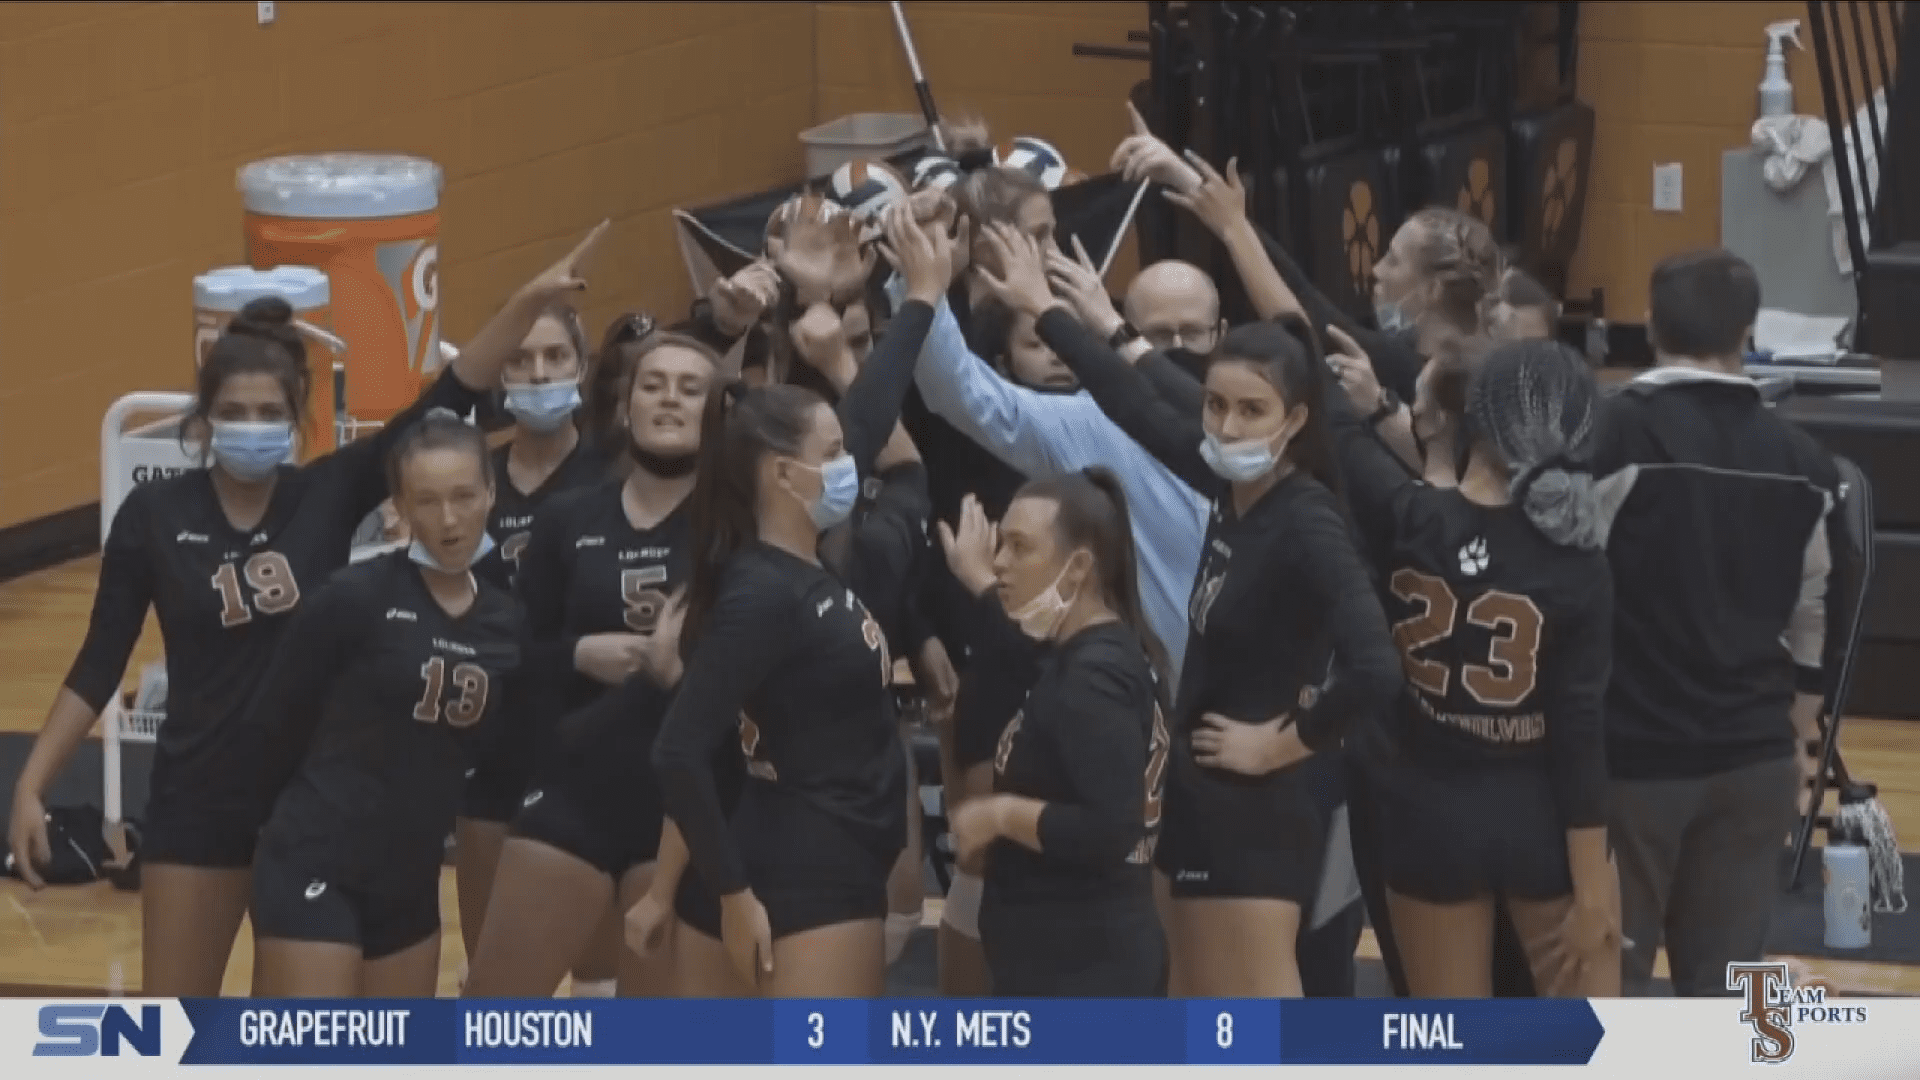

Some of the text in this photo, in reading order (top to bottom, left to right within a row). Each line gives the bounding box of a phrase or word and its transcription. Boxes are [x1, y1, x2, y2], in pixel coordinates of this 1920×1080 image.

[211, 550, 300, 628] 19
[621, 564, 667, 632] 5
[1390, 567, 1544, 706] 23
[413, 655, 489, 728] 13
